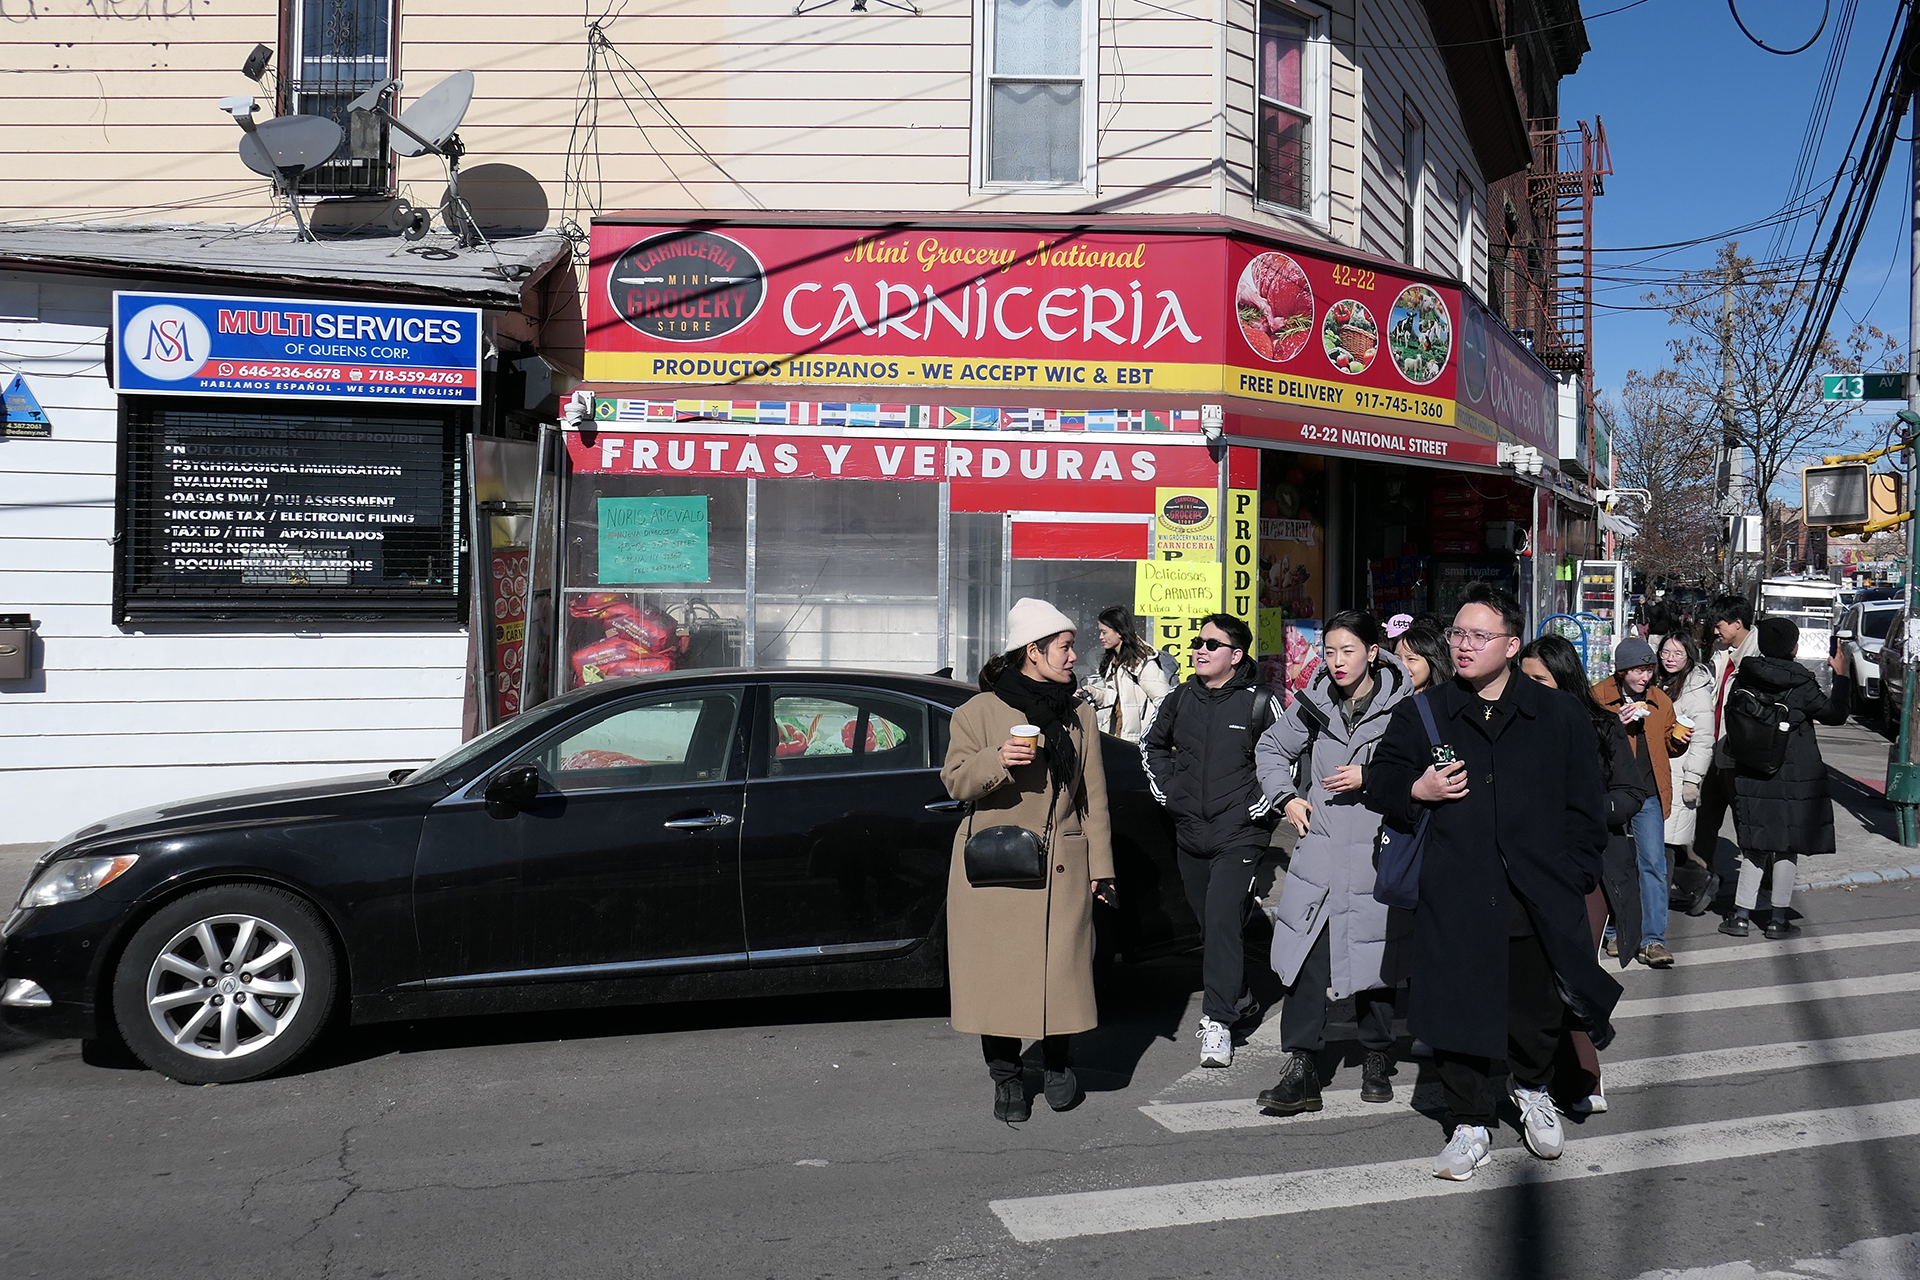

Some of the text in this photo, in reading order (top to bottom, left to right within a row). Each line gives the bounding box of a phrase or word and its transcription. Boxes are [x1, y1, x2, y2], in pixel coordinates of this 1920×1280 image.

[844, 237, 1146, 273] Mini Grocery National
[668, 274, 708, 285] MINI
[1331, 263, 1376, 292] 42-22
[626, 287, 748, 319] GROCERY
[657, 321, 711, 332] STORE
[285, 343, 411, 360] OF QUEENS CORP.
[238, 364, 342, 381] 646-236-6678
[368, 369, 463, 384] 718-559-4762
[651, 358, 782, 378] PRODUCTOS
[789, 360, 899, 379] HISPANOS
[921, 363, 957, 381] WE
[960, 364, 1038, 382] ACCEPT
[1045, 366, 1086, 384] WIC
[1092, 367, 1108, 384] &
[1116, 367, 1154, 385] EBT
[200, 380, 271, 390] HABLAMOS
[276, 381, 332, 392] ESPAÑOL
[346, 385, 366, 394] WE
[369, 385, 407, 395] SPEAK
[412, 387, 463, 397] ENGLISH
[1239, 374, 1344, 404] FREE DELIVERY
[1832, 377, 1895, 398] 43 AV
[1355, 391, 1444, 419] 917-745-1360
[356, 432, 424, 443] PROVIDER
[1300, 423, 1448, 457] 42-22 NATIONAL STREET
[172, 460, 402, 476] PSYCHOLOGICAL IMMIGRATION
[601, 438, 1158, 482] FRUTAS Y VERDURAS
[173, 476, 268, 489] EVALUATION
[172, 492, 224, 504] OASAS
[228, 493, 259, 504] DWI
[274, 494, 300, 506] DUI
[304, 495, 396, 508] ASSESSMENT
[172, 510, 234, 520] INCOME
[236, 511, 266, 521] TAX
[280, 512, 365, 523] ELECTRONIC
[368, 513, 415, 524] FILING
[606, 508, 646, 528] NORIS
[1170, 510, 1203, 519] GROCERY
[171, 526, 202, 537] TAX
[204, 526, 220, 537] ID
[280, 528, 385, 540] APOSTILLADOS
[171, 542, 224, 553] PUBLIC
[226, 543, 289, 554] NOTARY
[1157, 541, 1215, 550] CARNICERIA
[174, 559, 373, 571] DOCUMENT TRANSLATIONS
[1235, 494, 1251, 623] PRODU
[1444, 566, 1500, 576] smartwater
[1150, 583, 1213, 602] CARNITAS
